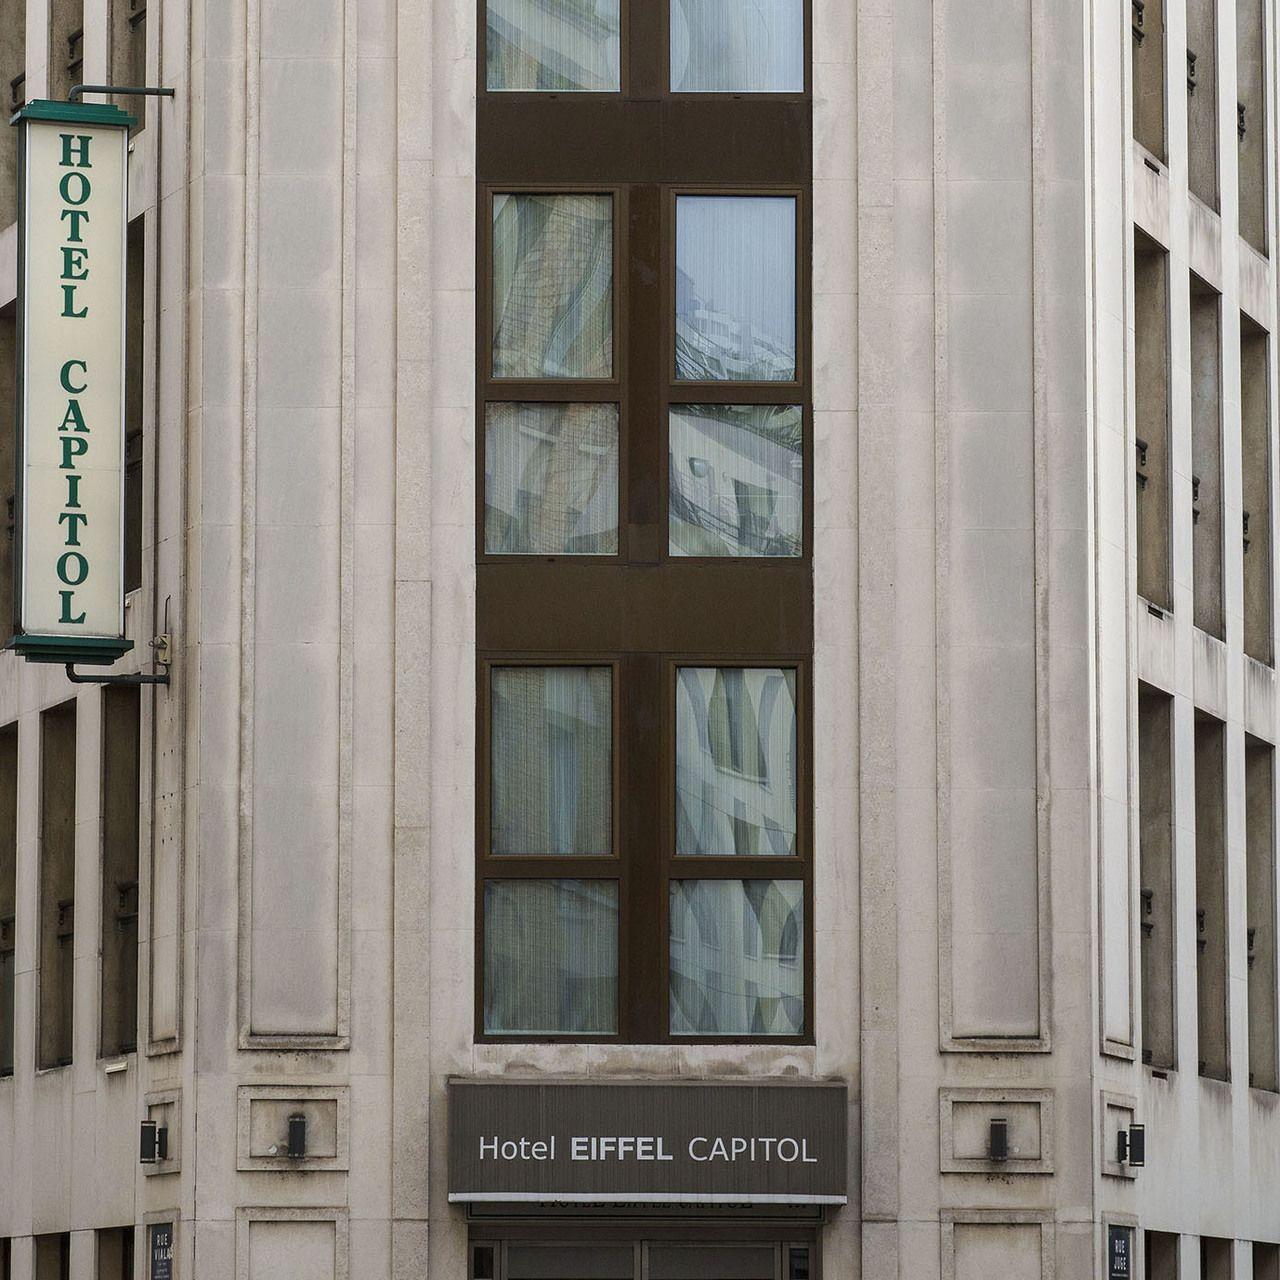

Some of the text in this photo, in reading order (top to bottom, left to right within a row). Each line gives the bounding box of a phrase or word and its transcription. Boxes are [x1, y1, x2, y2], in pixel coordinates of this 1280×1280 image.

[57, 133, 93, 625] HOTEL CAPITOL
[479, 1135, 818, 1163] Hotel EIFFEL CAPITOL
[156, 1233, 168, 1246] RUE
[1115, 1239, 1125, 1253] RUE
